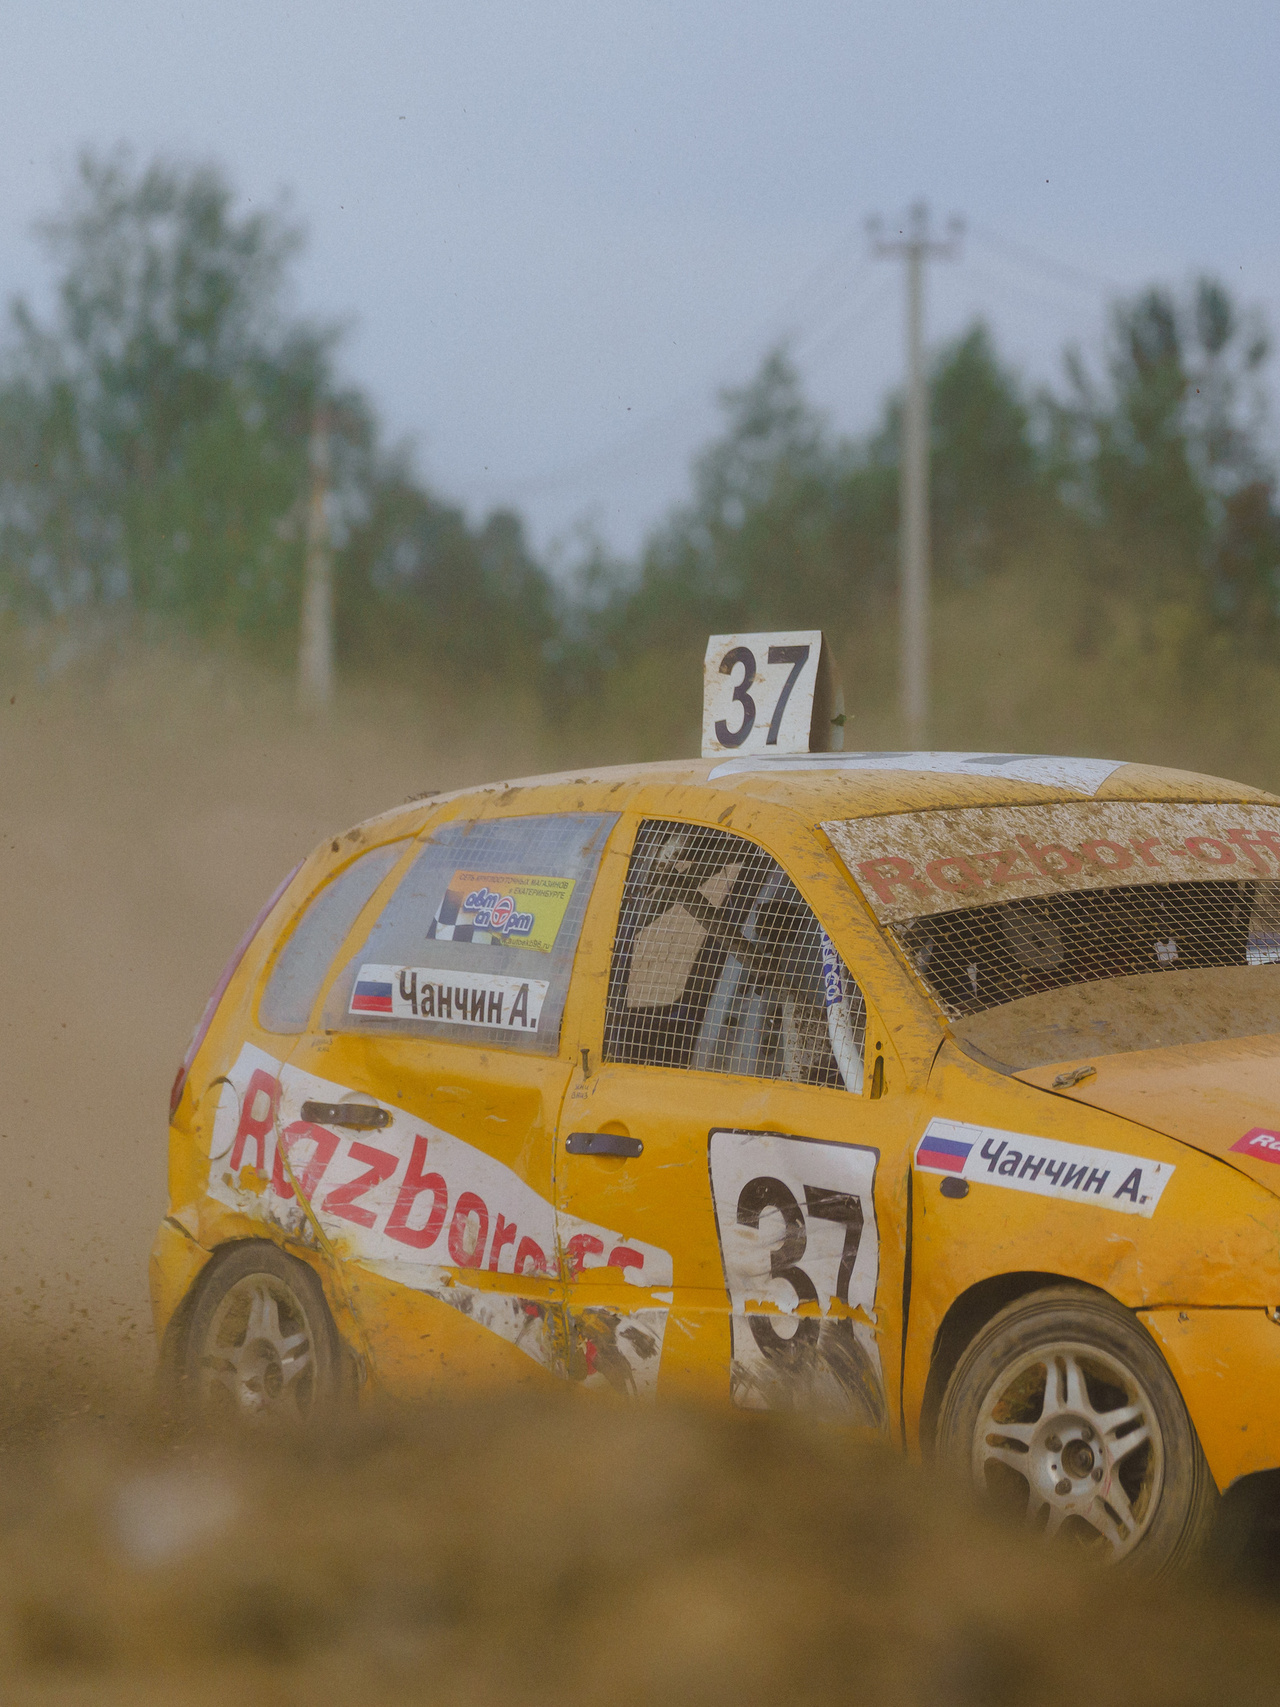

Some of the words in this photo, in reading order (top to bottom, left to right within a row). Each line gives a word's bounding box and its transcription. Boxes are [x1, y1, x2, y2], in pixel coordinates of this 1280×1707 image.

[714, 644, 811, 749] 37
[530, 878, 570, 890] МАГАЗИНОВ
[398, 970, 504, 1025] Чанчин
[508, 983, 537, 1029] А.
[978, 1138, 1105, 1195] Чанчин
[736, 1175, 865, 1362] 37
